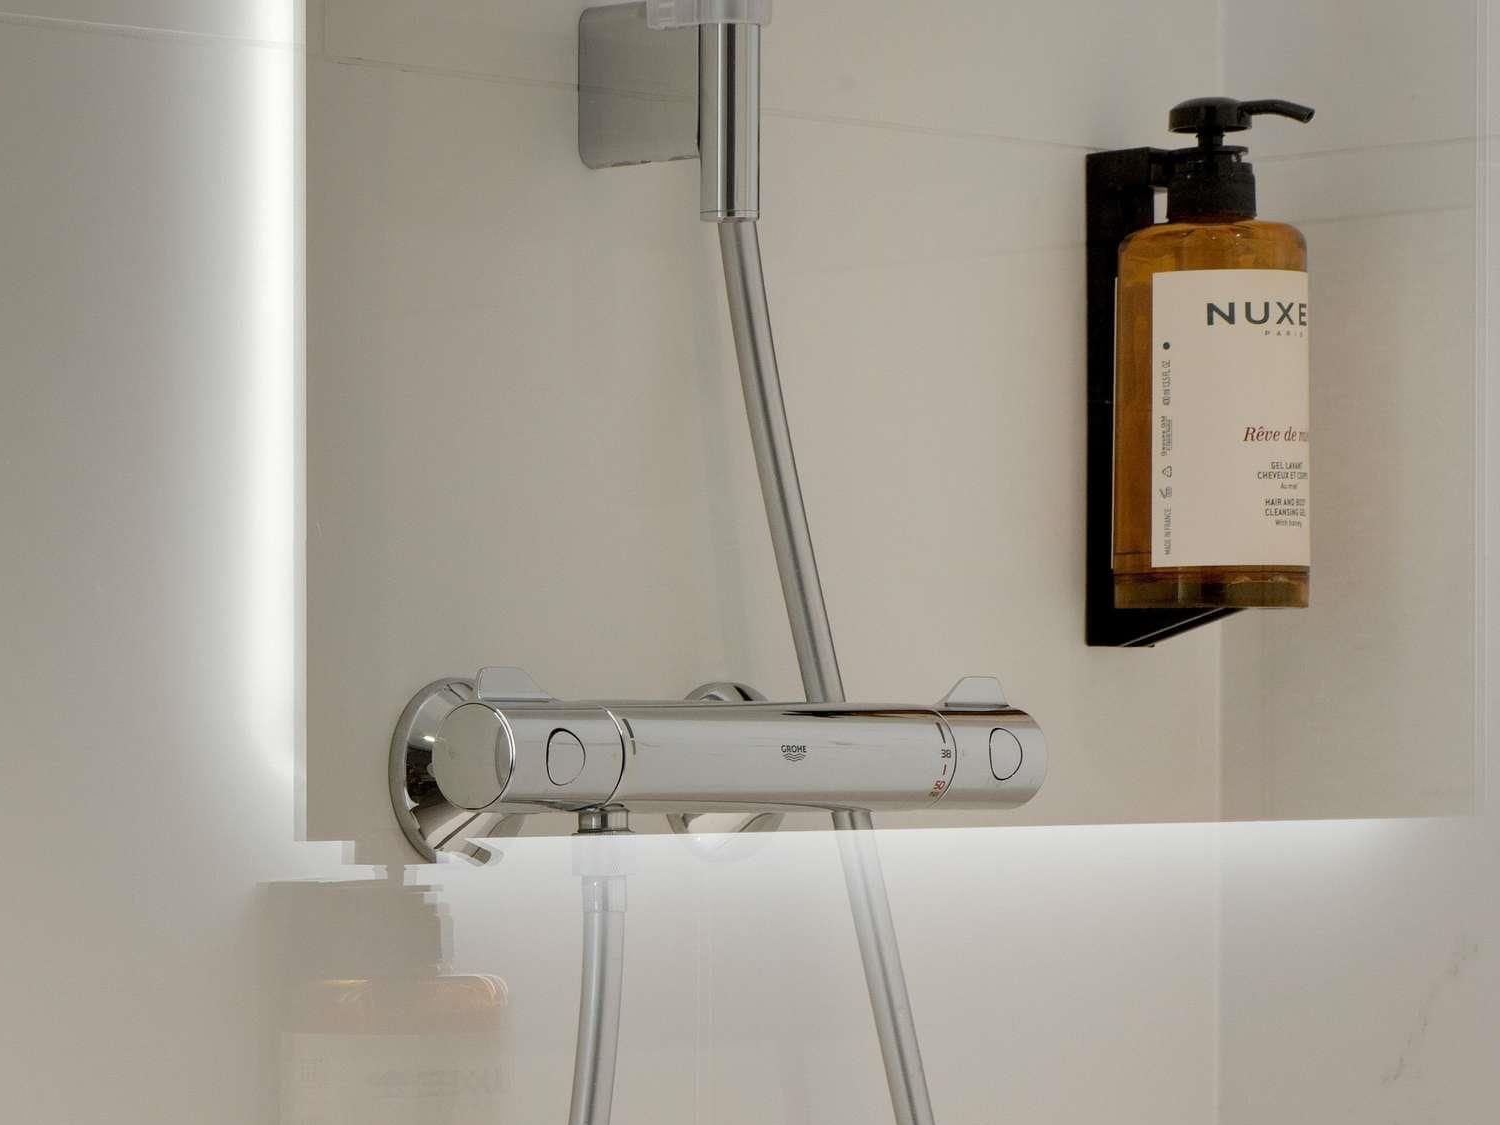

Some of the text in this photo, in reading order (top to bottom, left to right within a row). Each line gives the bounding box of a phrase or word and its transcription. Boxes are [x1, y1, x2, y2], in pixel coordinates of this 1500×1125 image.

[1206, 301, 1307, 326] NUXE
[1243, 426, 1280, 441] Rêve
[1284, 426, 1297, 441] de
[941, 749, 952, 758] 38
